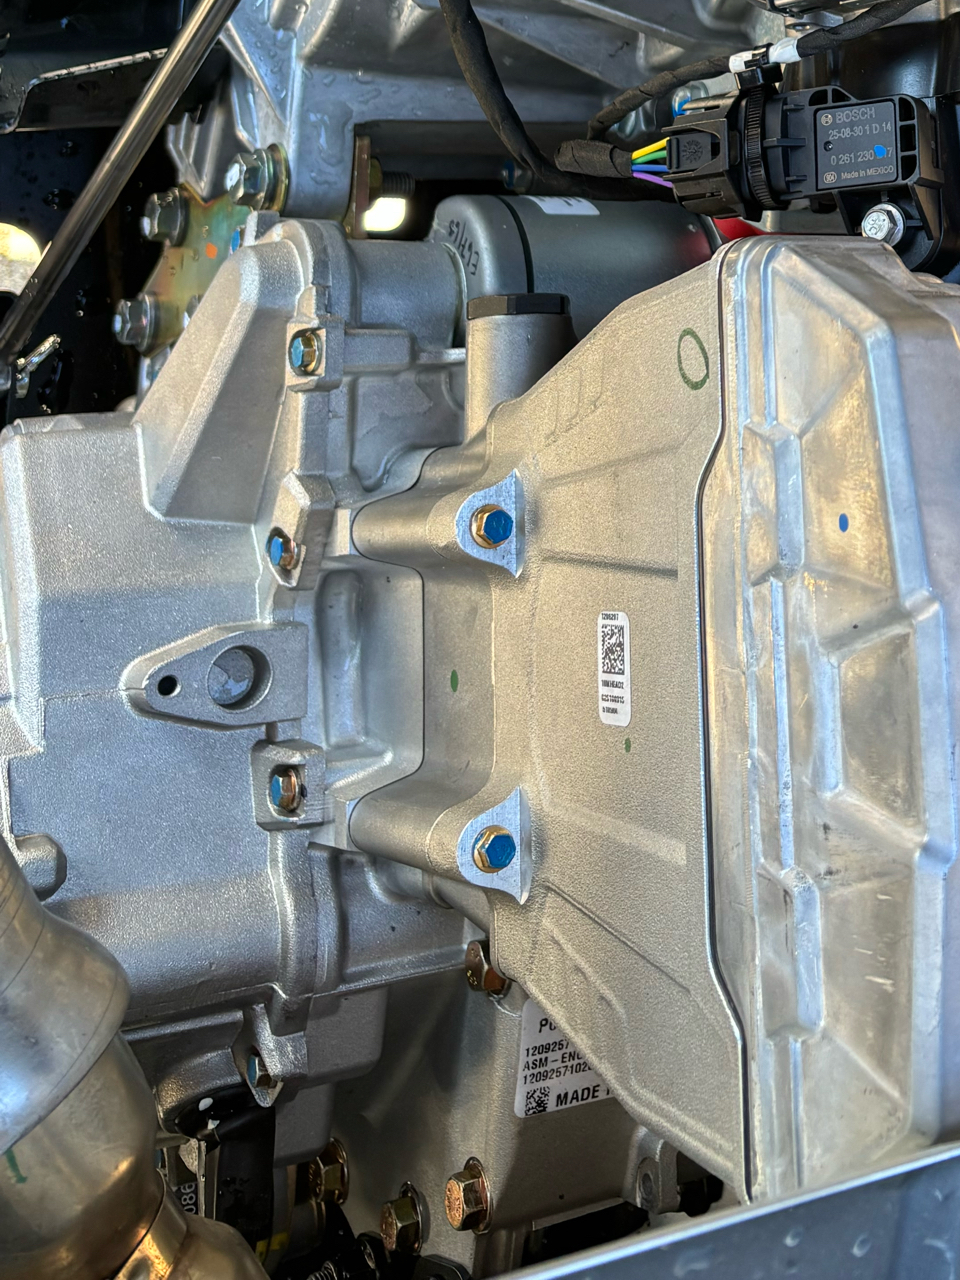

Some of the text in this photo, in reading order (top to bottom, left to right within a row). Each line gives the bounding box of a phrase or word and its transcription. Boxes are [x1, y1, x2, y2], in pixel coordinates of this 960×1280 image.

[835, 107, 875, 124] BOSCH
[828, 125, 863, 140] 25-08-30
[872, 123, 880, 134] D
[881, 121, 892, 132] 14
[830, 155, 837, 165] 0
[838, 152, 855, 165] 261
[857, 150, 874, 162] 230
[841, 171, 859, 179] Made
[859, 169, 866, 177] in
[866, 165, 894, 176] MEXICO
[556, 1084, 600, 1107] MADE
